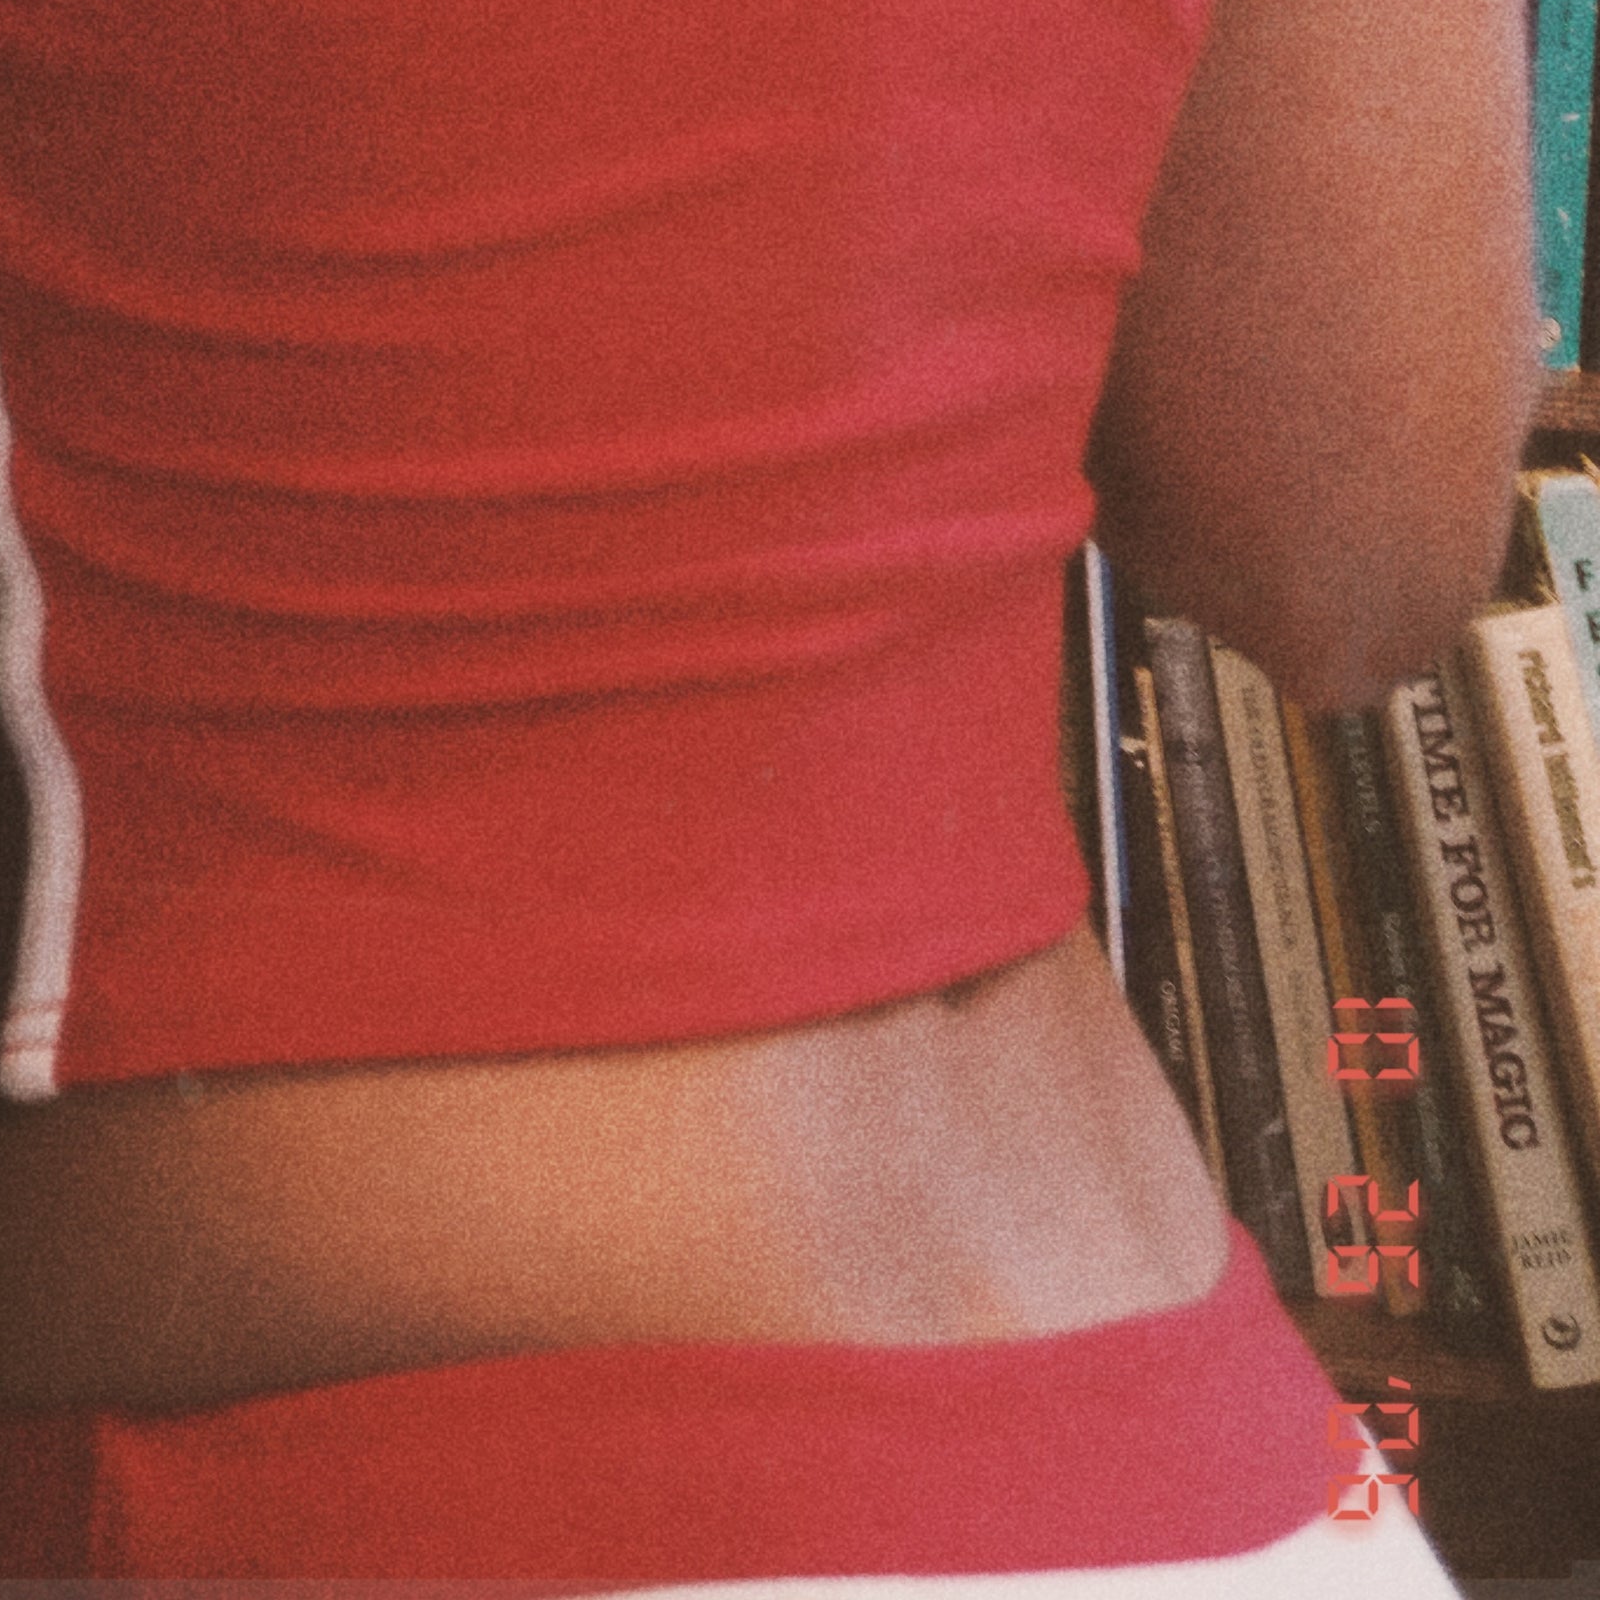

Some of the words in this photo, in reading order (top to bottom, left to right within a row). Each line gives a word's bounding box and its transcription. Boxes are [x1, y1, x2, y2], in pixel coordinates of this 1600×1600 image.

[1405, 664, 1466, 822] TIME
[1440, 837, 1496, 951] FOR
[1468, 966, 1541, 1151] MAGIC
